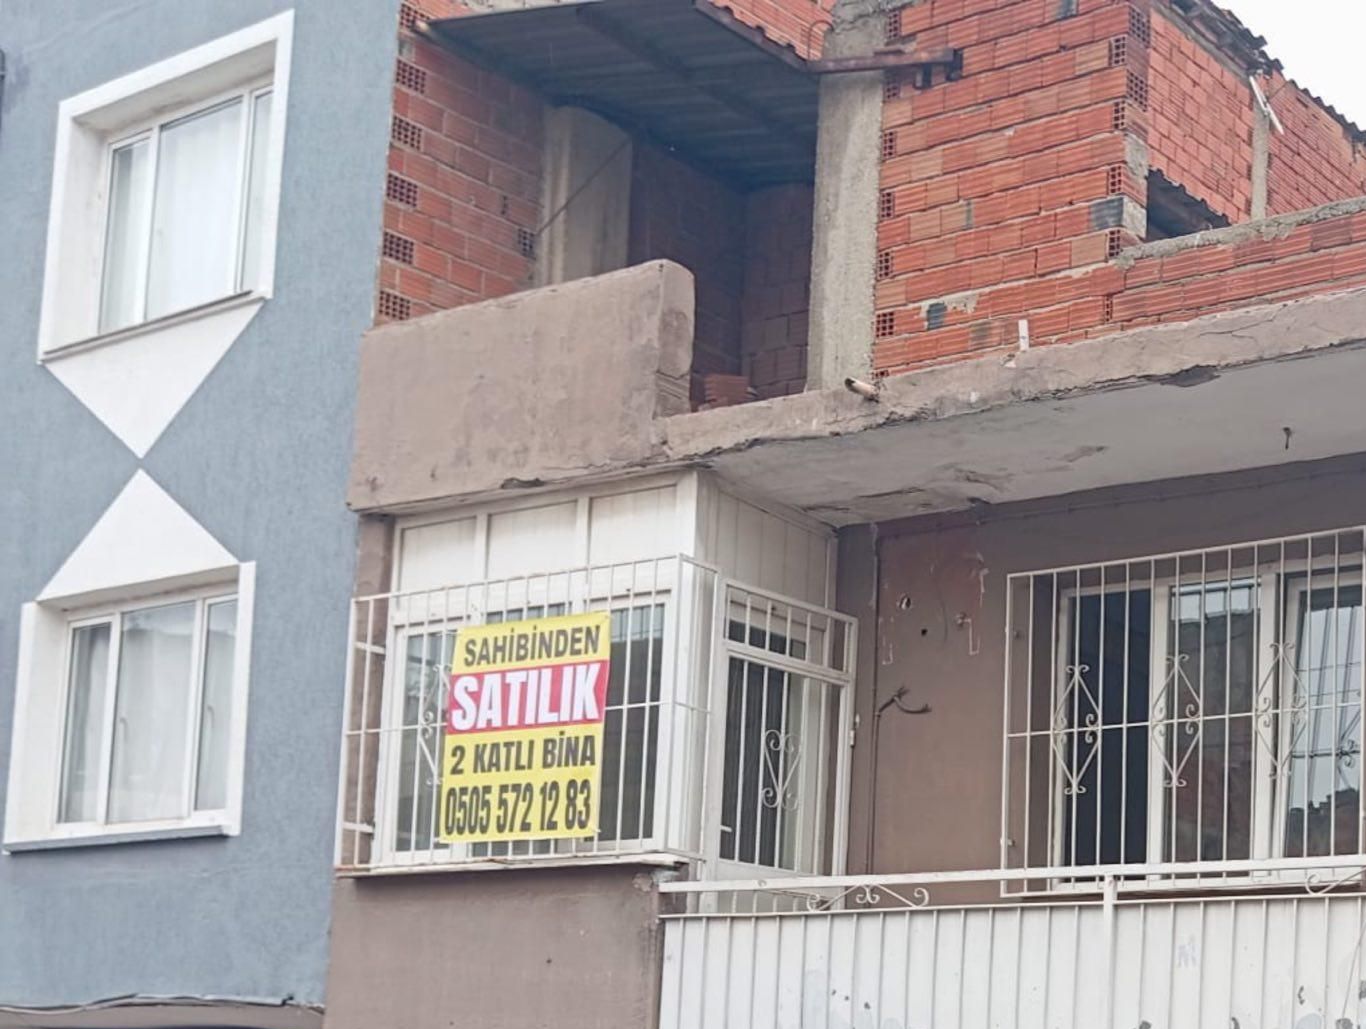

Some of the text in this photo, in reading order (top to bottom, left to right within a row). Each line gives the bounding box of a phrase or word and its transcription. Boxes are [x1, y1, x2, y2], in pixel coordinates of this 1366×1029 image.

[463, 624, 601, 667] SAHİBİNDEN
[451, 663, 602, 732] SATILIK
[450, 730, 596, 776] 2 KATLI BİNA
[444, 778, 592, 836] 0505 572 12 83
